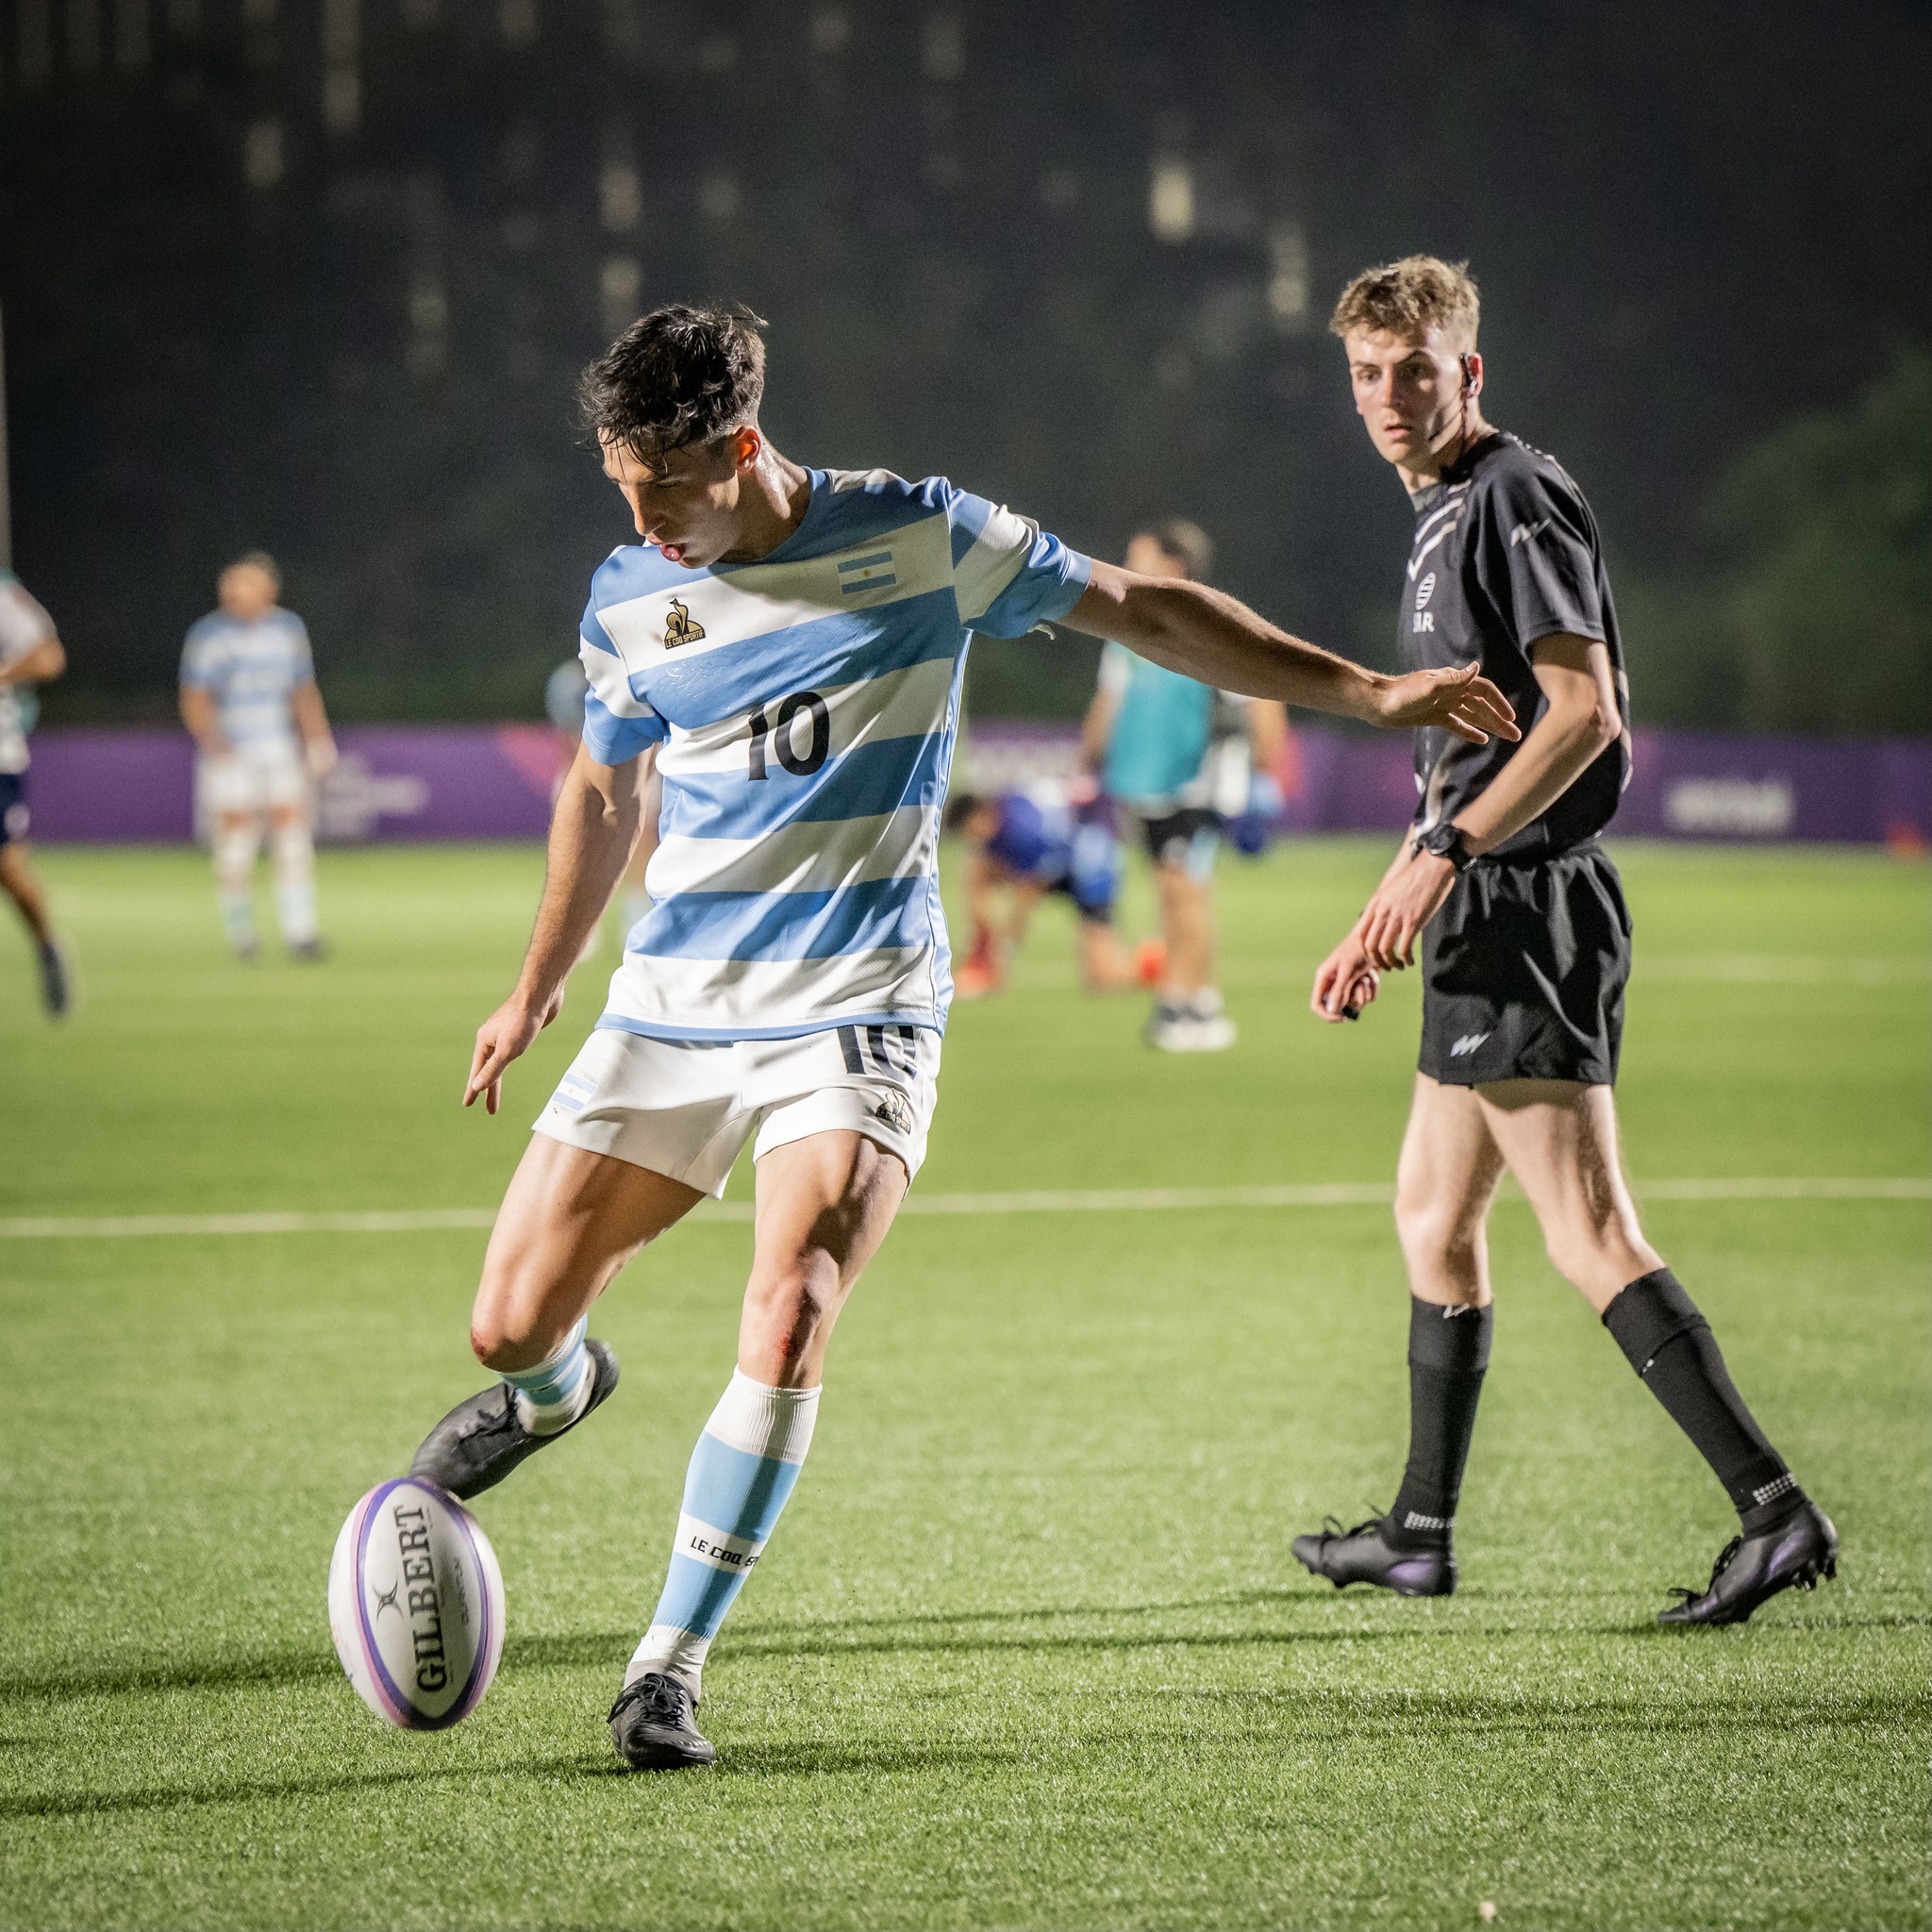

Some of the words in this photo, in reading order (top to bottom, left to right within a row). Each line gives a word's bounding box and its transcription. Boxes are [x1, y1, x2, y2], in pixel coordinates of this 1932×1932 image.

[683, 629, 704, 642] SPORTIF
[747, 691, 831, 781] 10
[691, 1536, 708, 1553] LE
[708, 1545, 743, 1566] COQ
[393, 1504, 447, 1692] GILBERT
